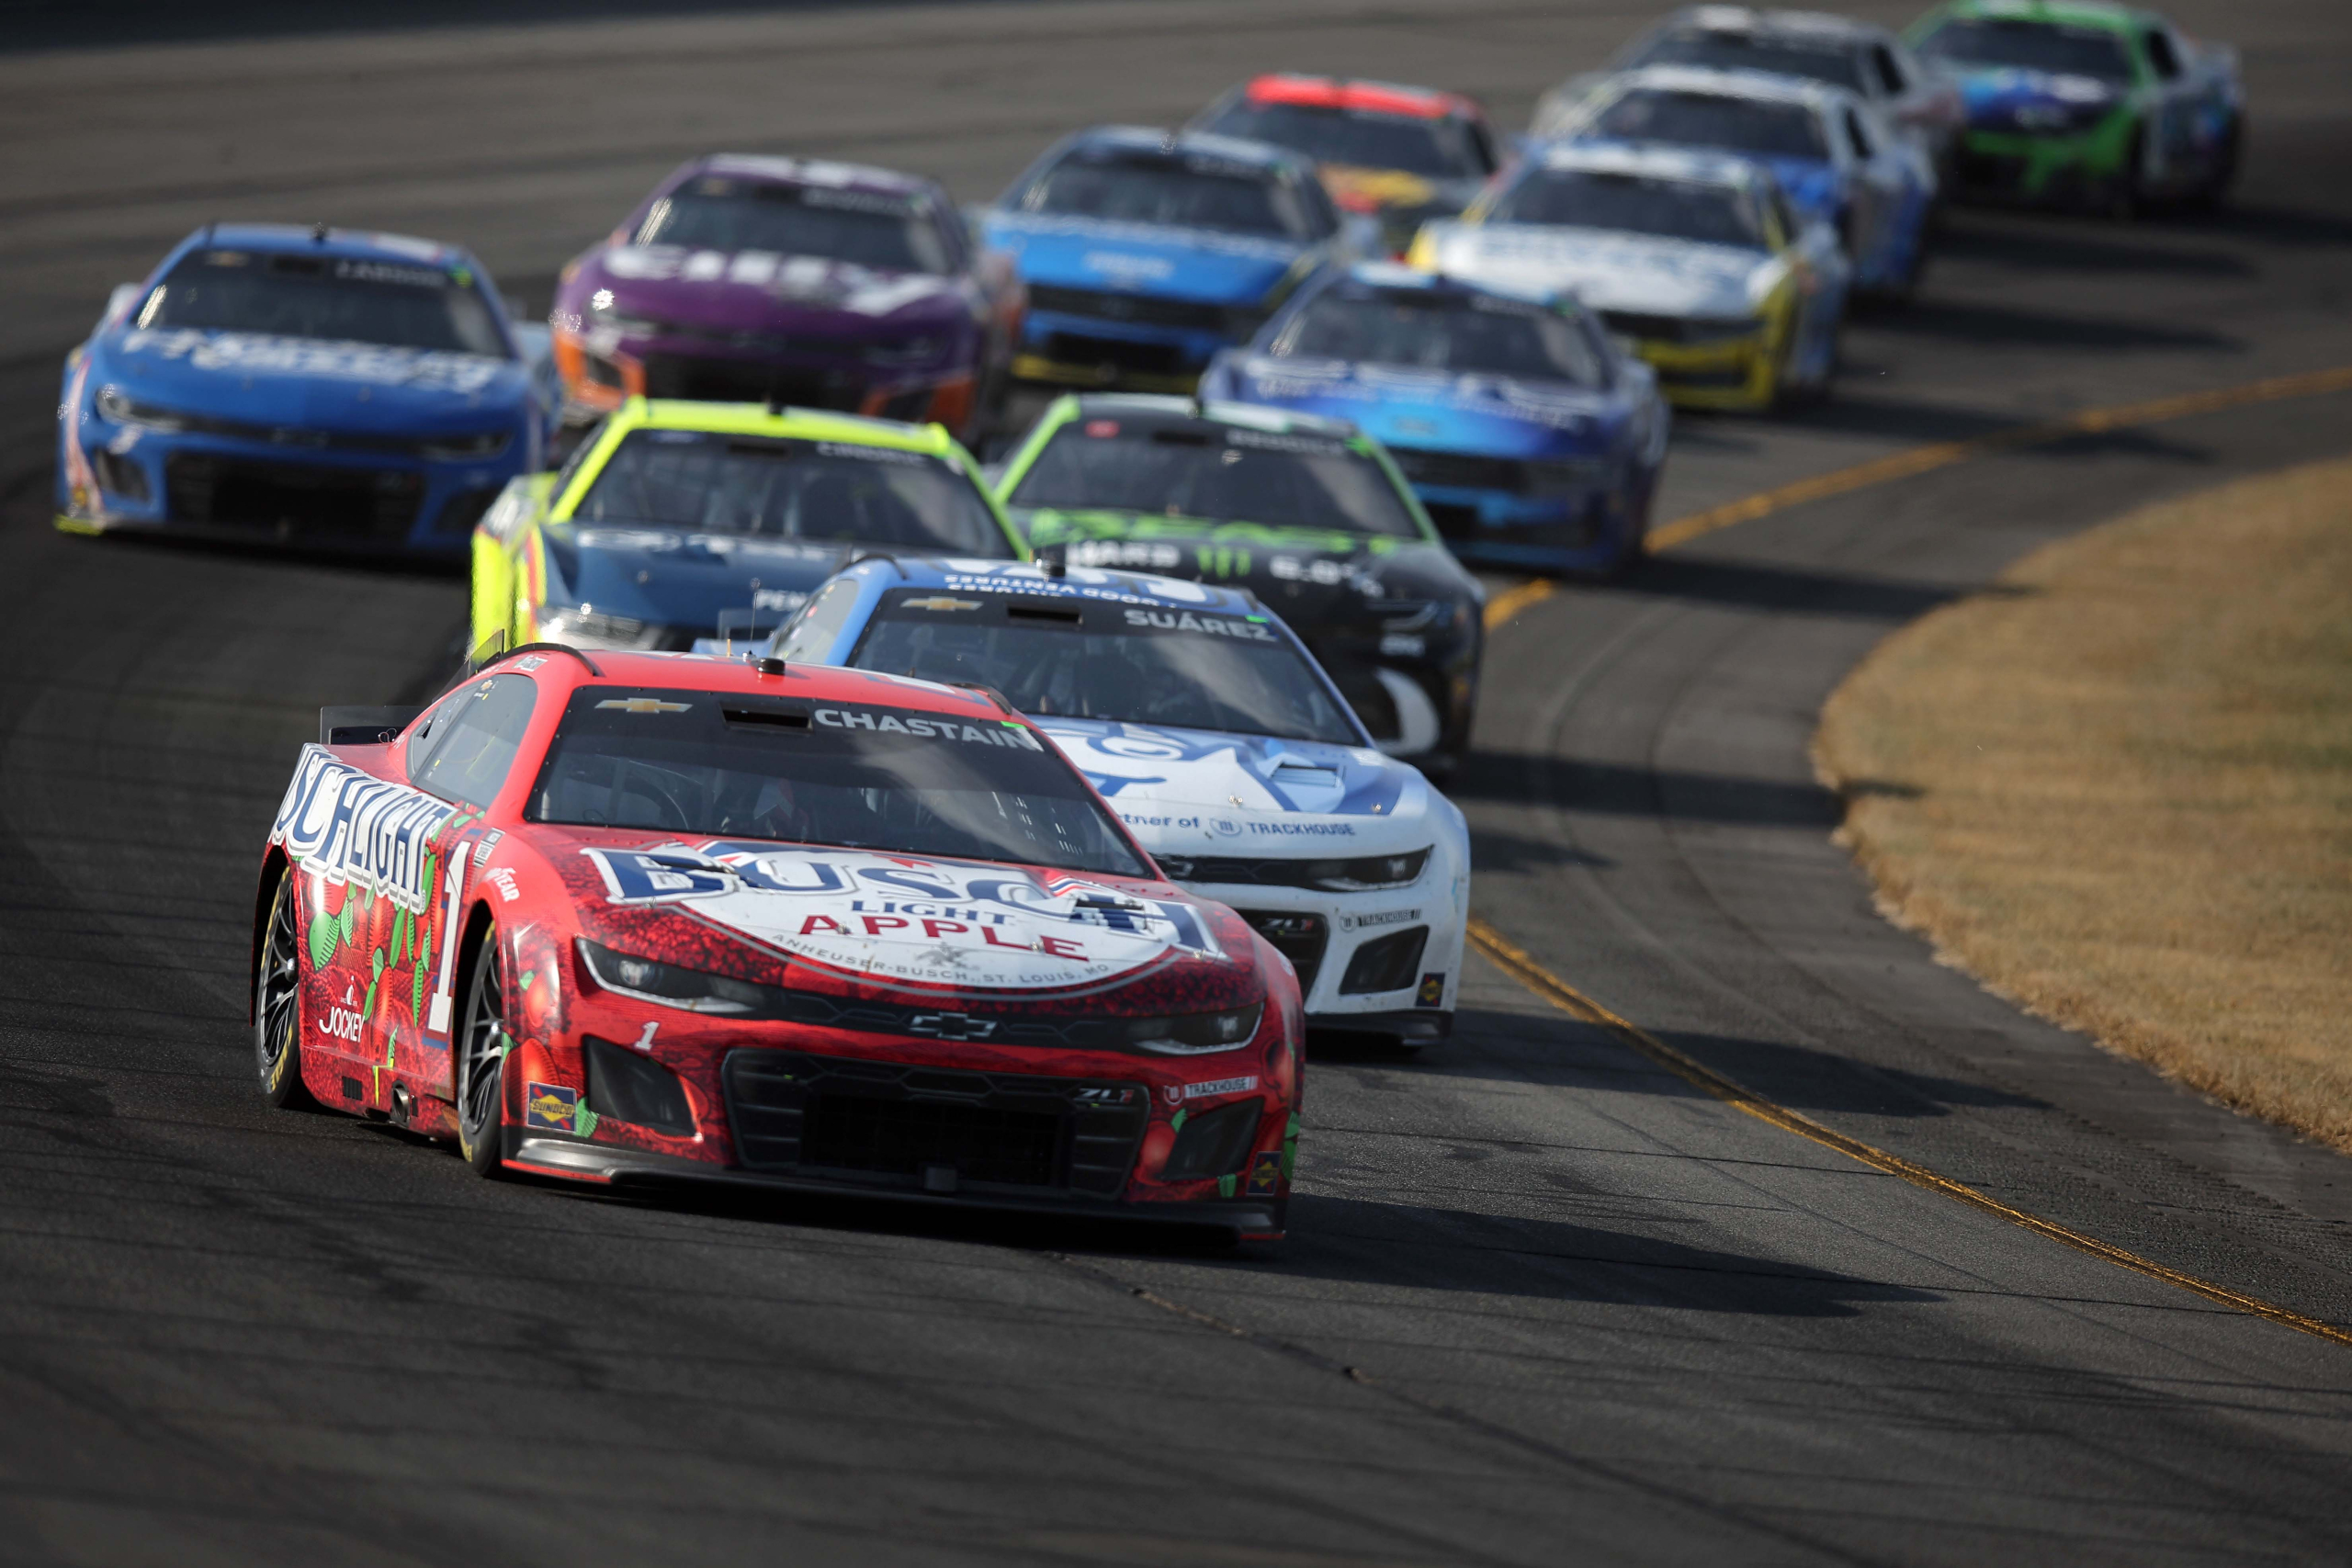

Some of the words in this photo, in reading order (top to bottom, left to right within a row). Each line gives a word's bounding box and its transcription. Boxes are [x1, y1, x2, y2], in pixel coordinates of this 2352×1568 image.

[1124, 608, 1277, 642] SUÁREZ
[814, 708, 1041, 751] CHASTAIN
[1178, 817, 1200, 829] of
[1248, 821, 1356, 836] TRACKHOUSE
[584, 843, 1220, 960] BUSCH
[851, 900, 1014, 925] LIGHT
[425, 839, 472, 1034] 1
[799, 915, 1090, 963] APPLE
[319, 1006, 365, 1043] JOCKEY
[634, 1021, 660, 1051] 1
[1072, 1088, 1135, 1103] ZL1
[1188, 1077, 1250, 1098] TRACKHOUSE
